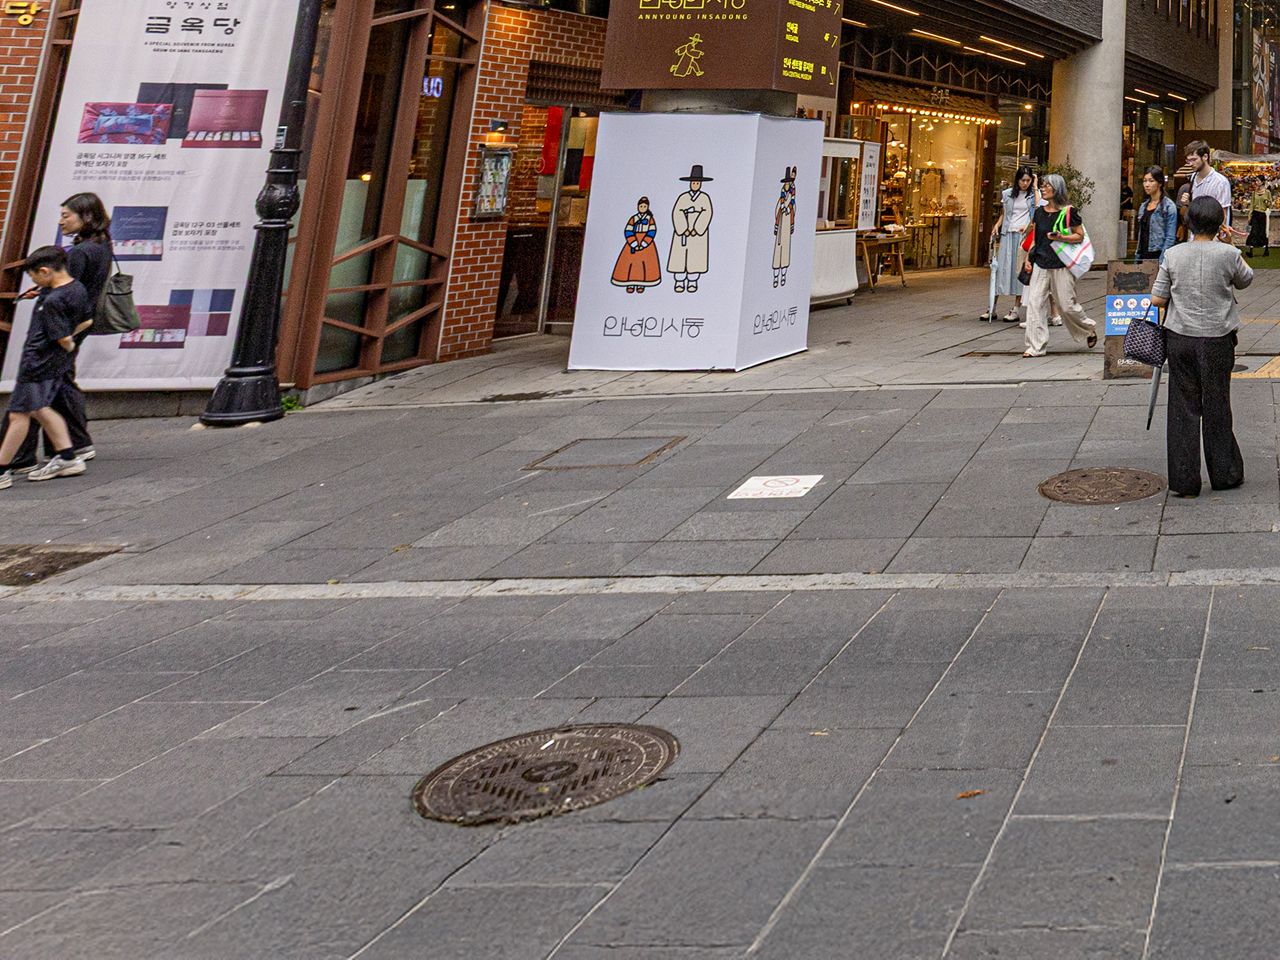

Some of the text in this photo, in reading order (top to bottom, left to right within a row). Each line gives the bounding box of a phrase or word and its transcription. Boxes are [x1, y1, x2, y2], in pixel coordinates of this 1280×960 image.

[145, 16, 241, 35] 금옥당
[603, 315, 705, 339] 안녕인사동
[753, 305, 798, 336] 안녕인사동
